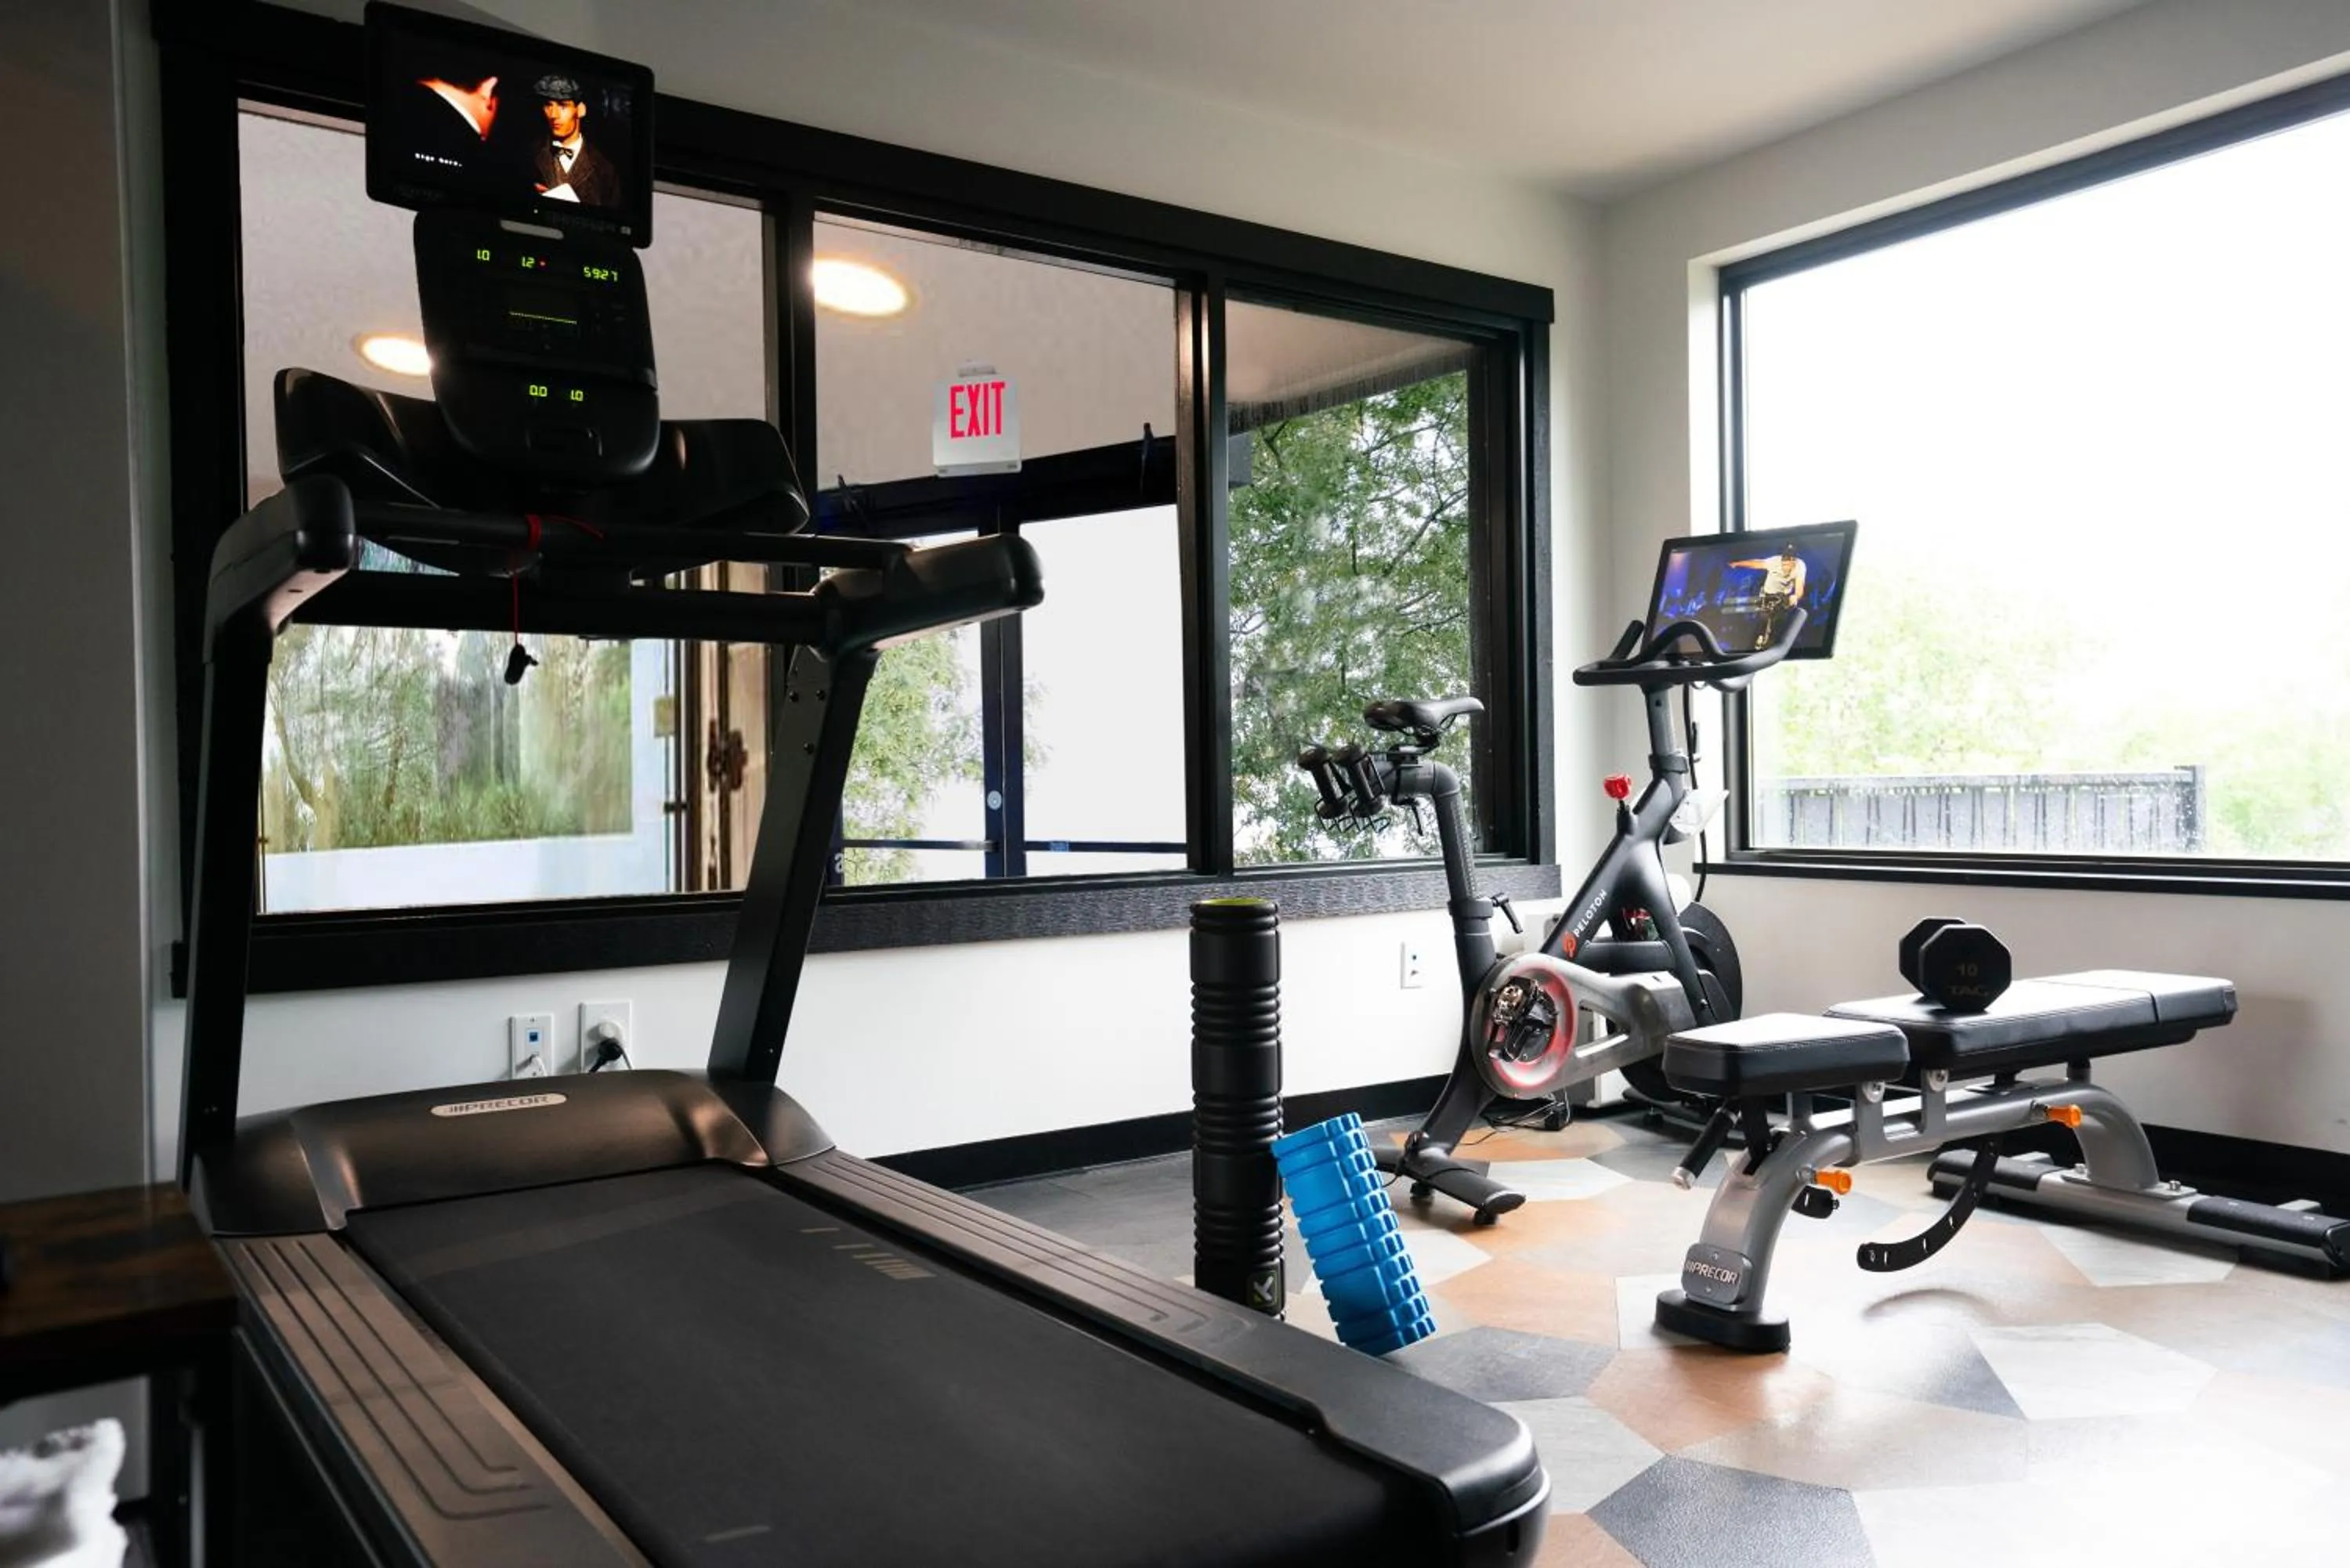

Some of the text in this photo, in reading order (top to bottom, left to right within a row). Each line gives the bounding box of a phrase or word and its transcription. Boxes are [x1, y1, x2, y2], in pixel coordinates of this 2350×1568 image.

[949, 381, 1005, 439] EXIT
[1573, 889, 1607, 938] PELOTON
[1955, 963, 1978, 977] 10
[1691, 1261, 1739, 1285] PRECOR
